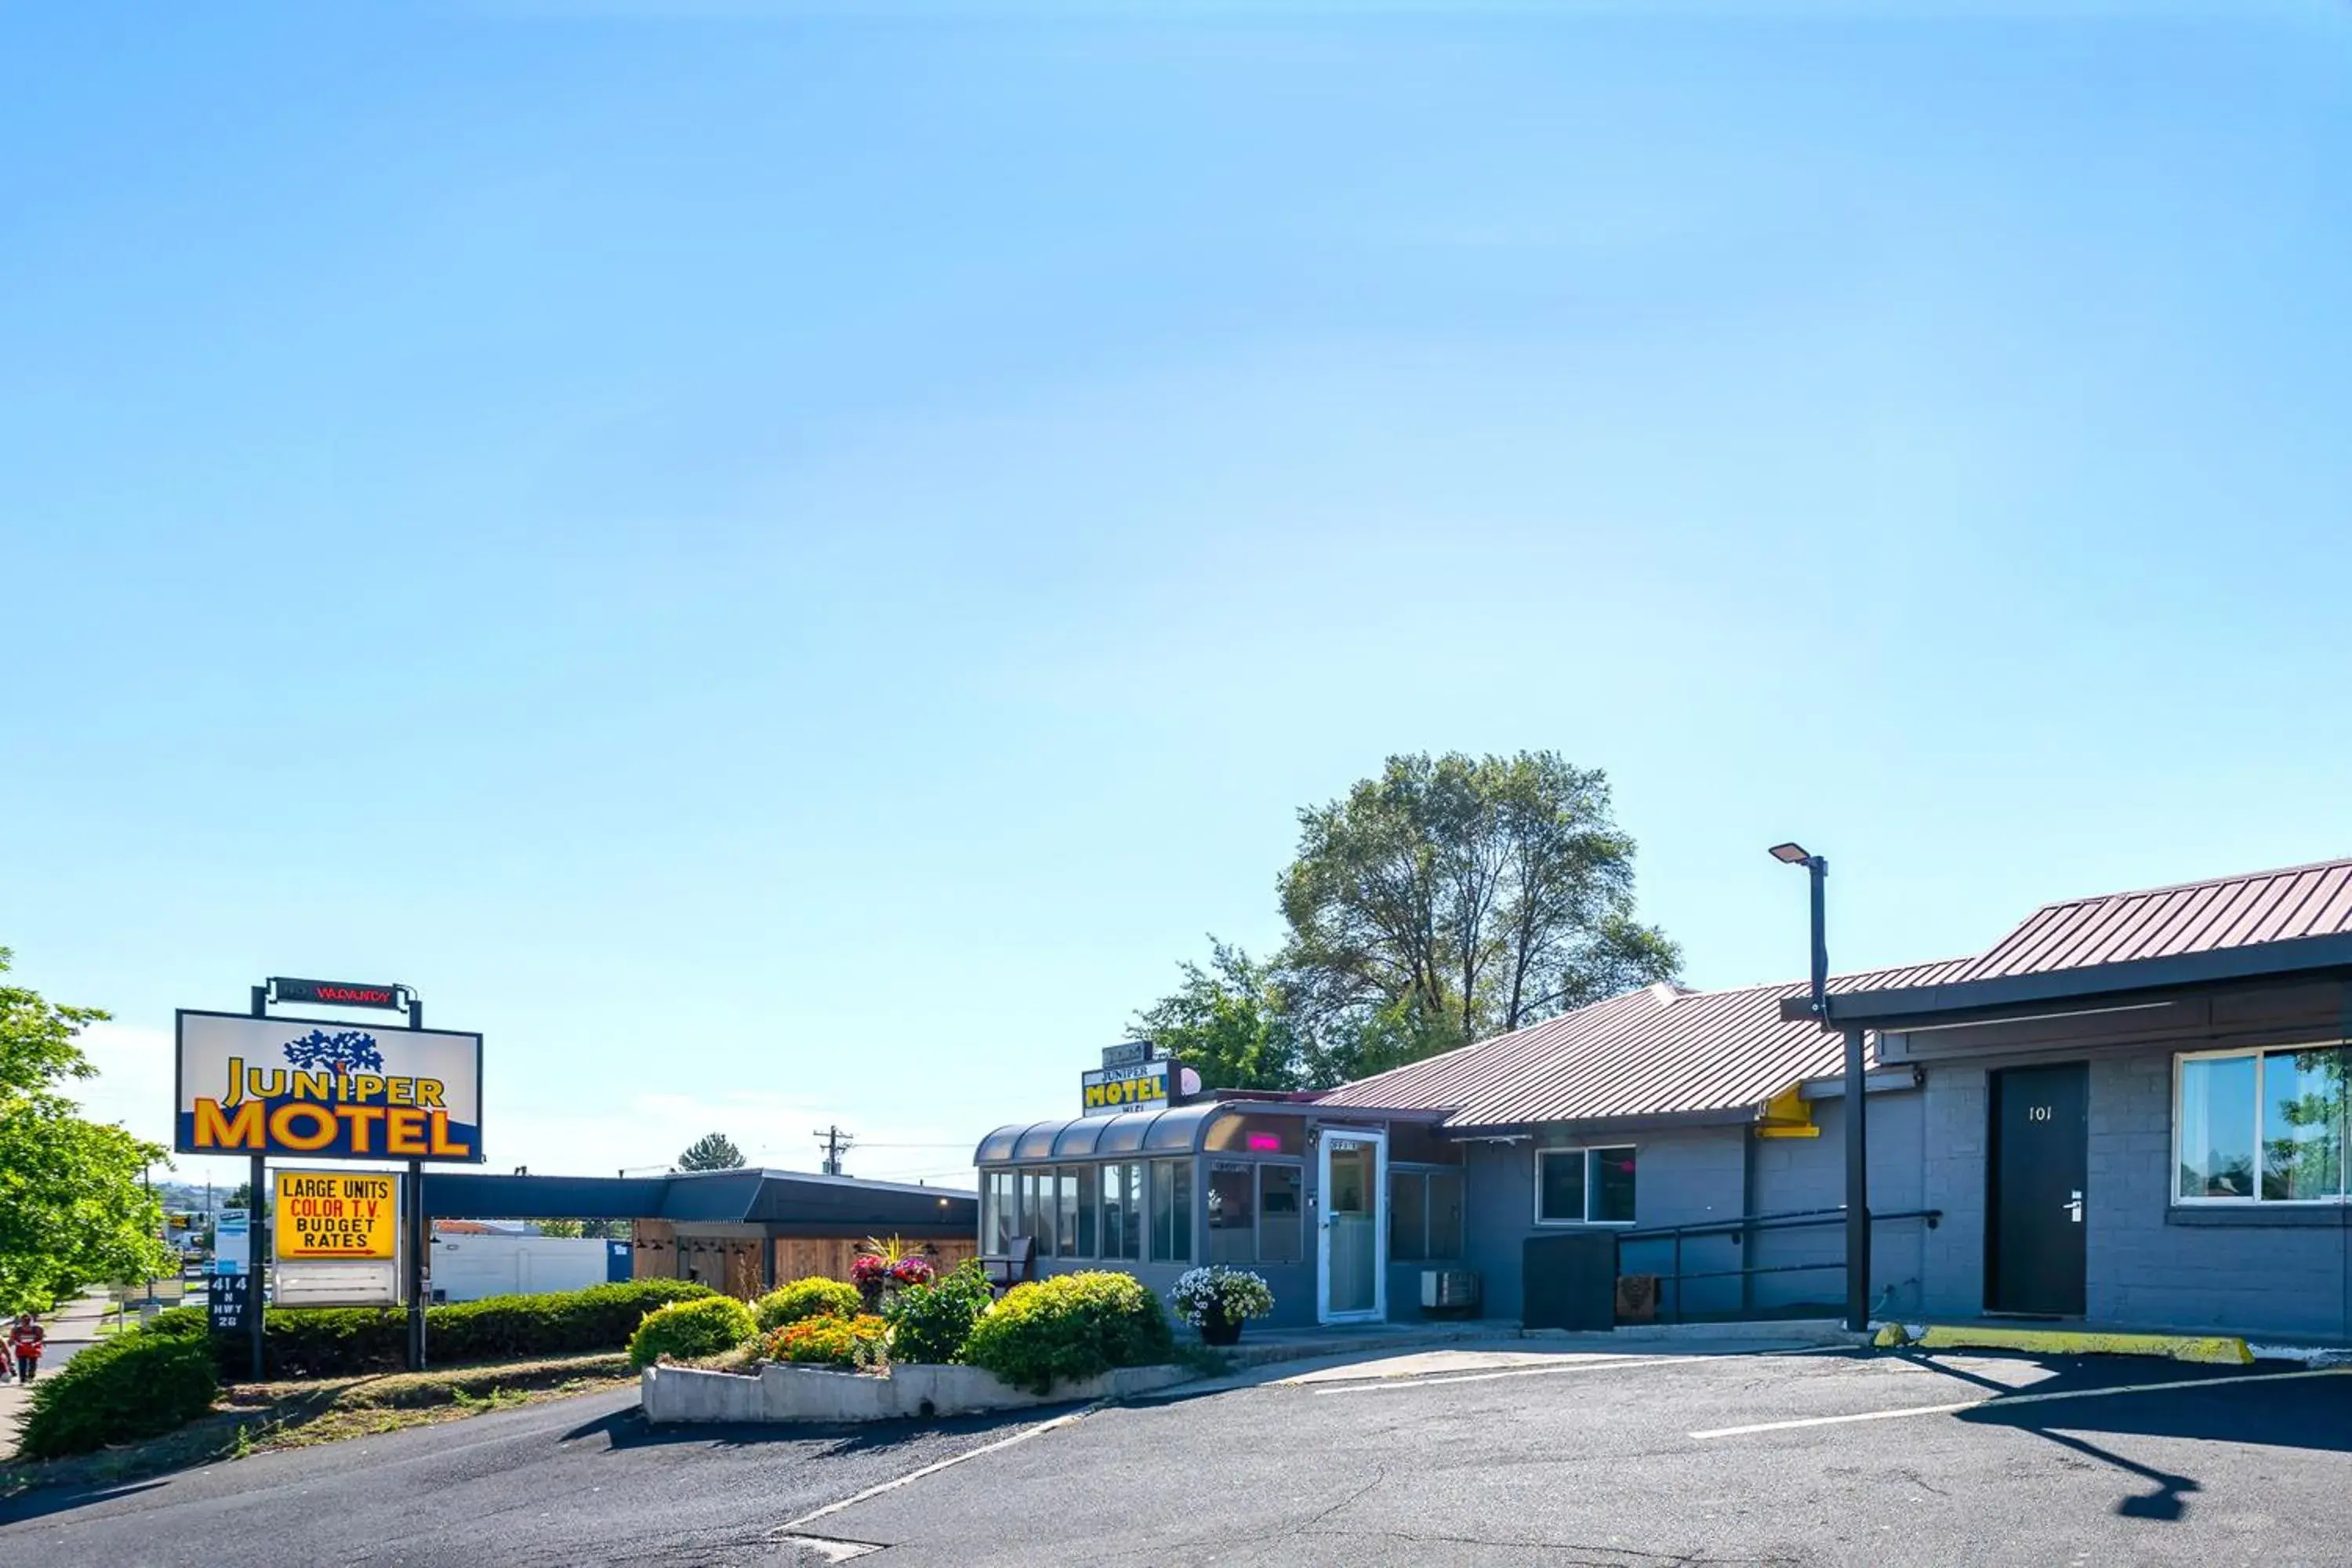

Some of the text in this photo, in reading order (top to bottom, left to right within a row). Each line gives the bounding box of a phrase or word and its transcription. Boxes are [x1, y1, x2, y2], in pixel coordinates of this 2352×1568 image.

[316, 986, 390, 1003] VACANCY
[1102, 1066, 1148, 1082] JUNIPER
[222, 1057, 446, 1108] JUNIPER
[1085, 1076, 1167, 1107] MOTEL
[2030, 1105, 2052, 1121] 101
[194, 1098, 470, 1156] MOTEL
[283, 1178, 389, 1199] LARGE UNITS
[290, 1198, 381, 1218] COLOR T.V.
[296, 1218, 375, 1233] BUDGET
[304, 1233, 368, 1247] RATES
[212, 1277, 247, 1290] 414
[224, 1292, 233, 1302] N
[213, 1304, 242, 1314] HWY
